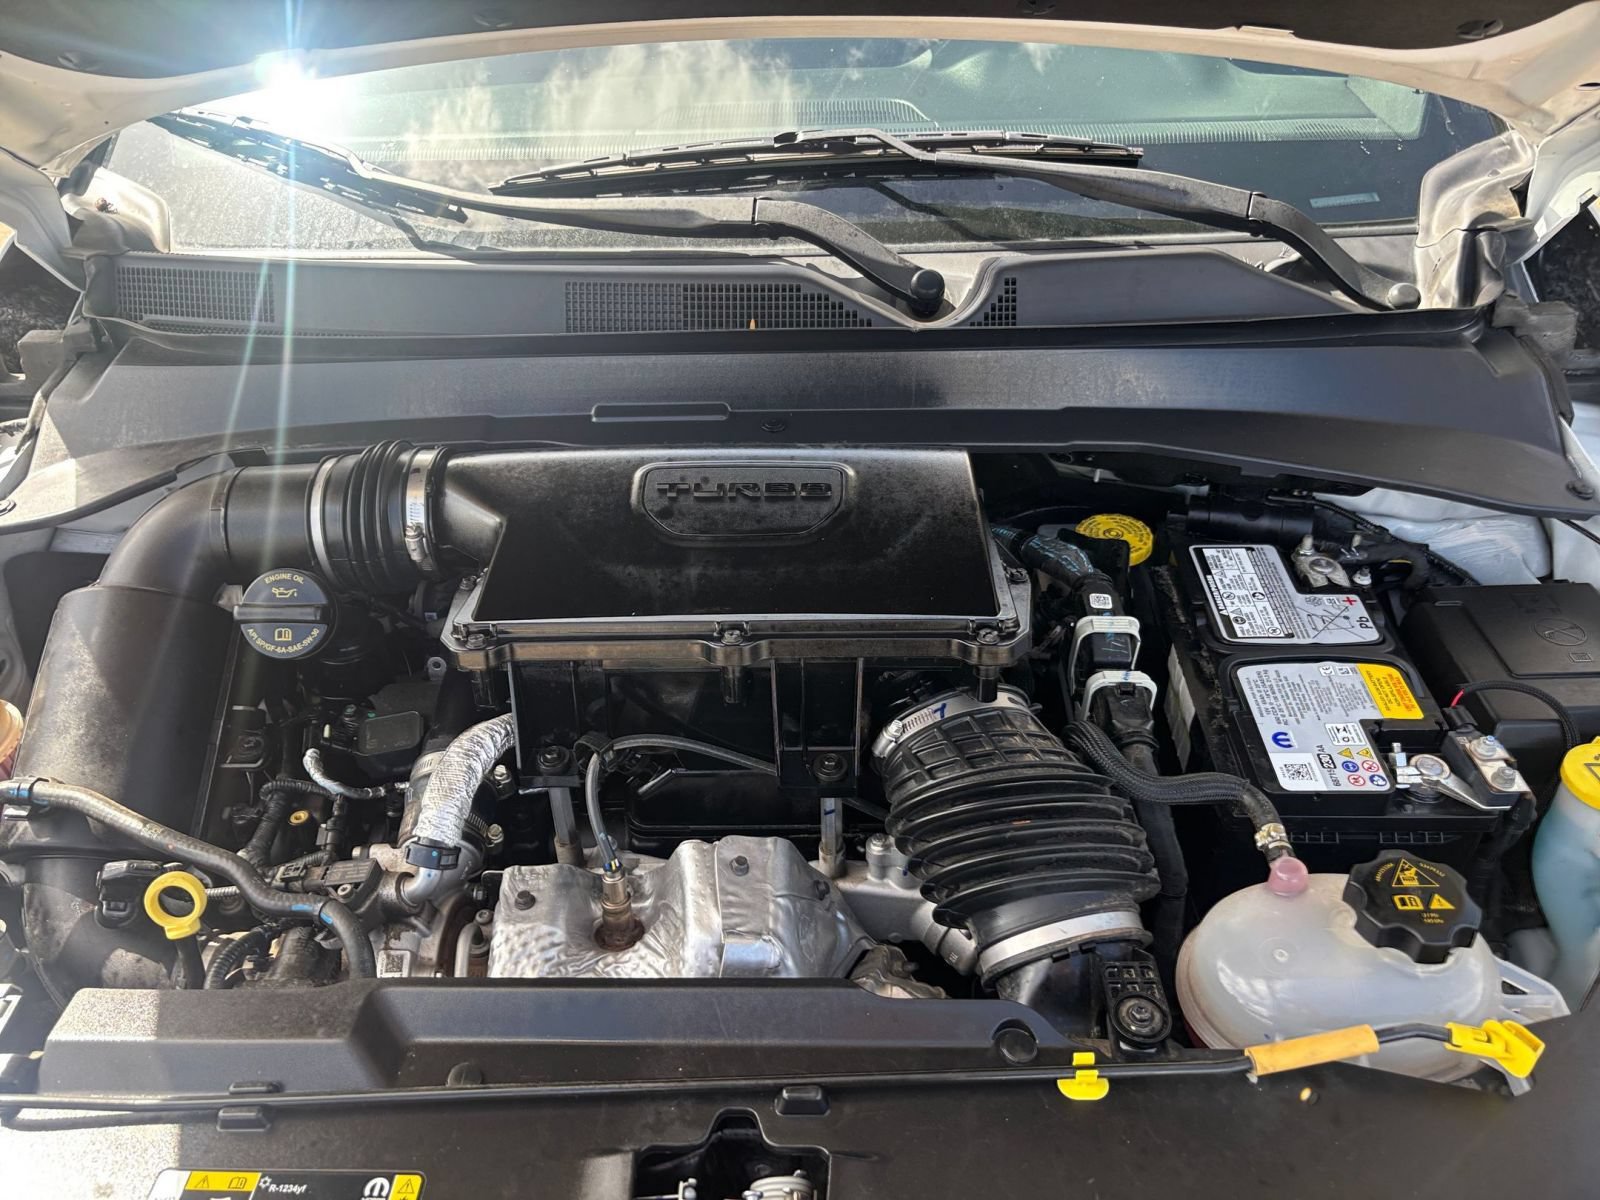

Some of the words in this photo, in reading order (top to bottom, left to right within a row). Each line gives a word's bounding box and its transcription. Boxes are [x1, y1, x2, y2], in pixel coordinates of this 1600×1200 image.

[656, 482, 832, 500] TURBO
[264, 573, 292, 584] ENGINE
[292, 574, 304, 584] OIL
[1356, 616, 1373, 628] Pb
[247, 628, 257, 640] API
[1316, 744, 1325, 752] AA
[268, 1184, 308, 1195] R-1234yf
